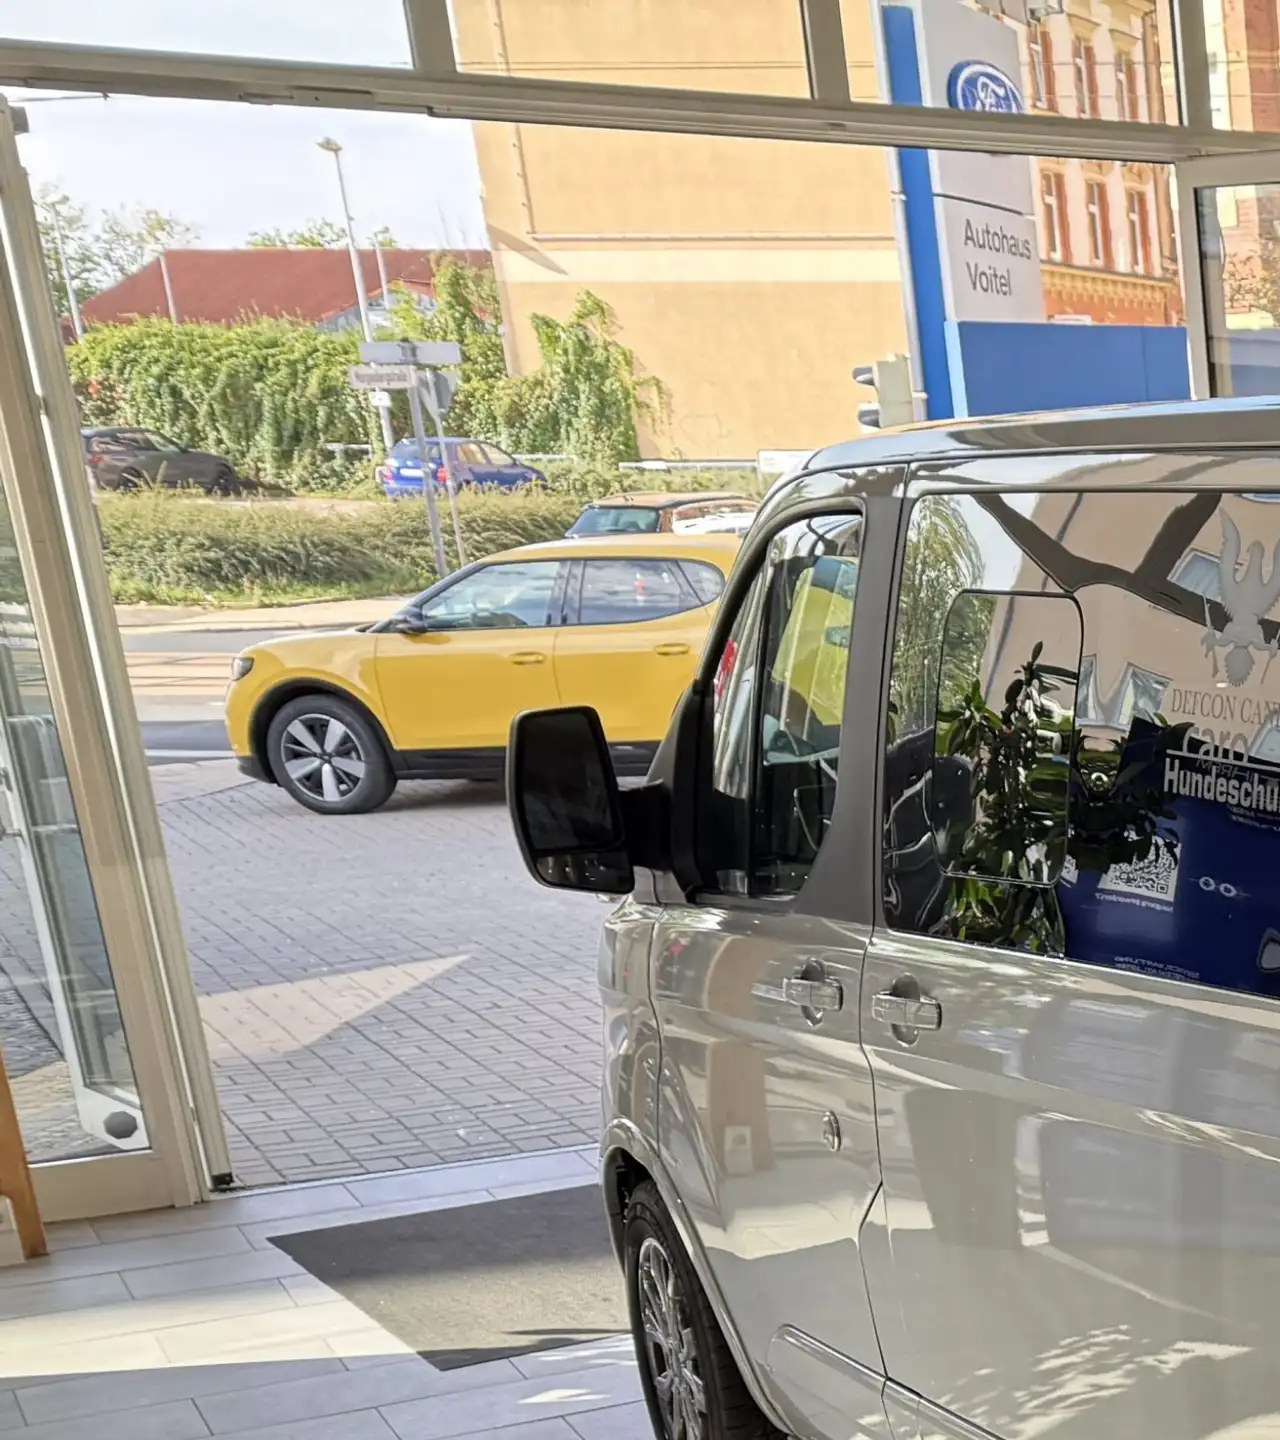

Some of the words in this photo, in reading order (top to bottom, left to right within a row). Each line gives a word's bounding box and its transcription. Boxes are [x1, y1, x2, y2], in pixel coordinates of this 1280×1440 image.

[964, 218, 1031, 260] Autohaus
[966, 261, 1013, 297] Voitel
[1171, 688, 1237, 720] DEFCON
